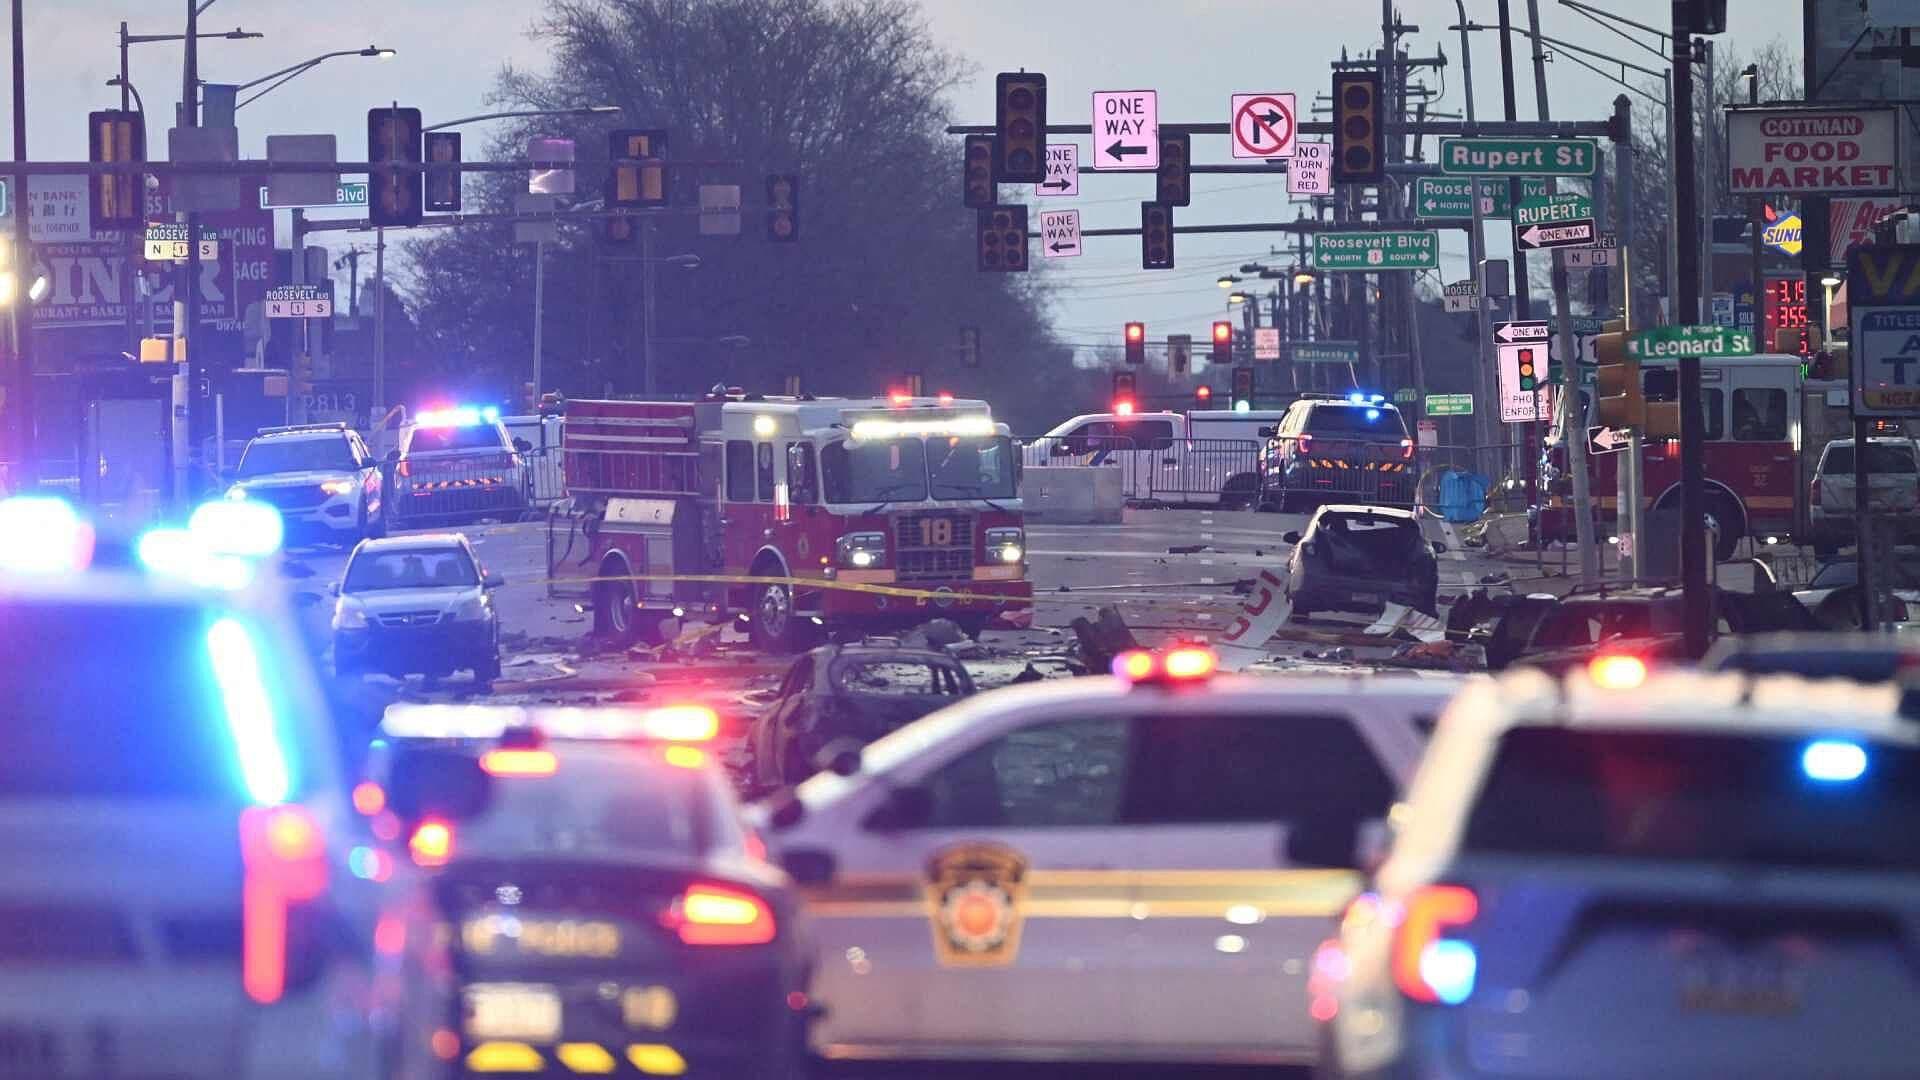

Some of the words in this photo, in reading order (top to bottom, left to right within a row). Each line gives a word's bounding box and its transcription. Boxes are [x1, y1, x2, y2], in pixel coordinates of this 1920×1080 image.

[1105, 98, 1144, 115] ONE
[1105, 119, 1144, 135] WAY
[1764, 118, 1857, 135] COTTMAN
[1299, 146, 1319, 158] NO
[1453, 146, 1543, 169] Rupert
[1556, 146, 1584, 166] St
[1764, 141, 1861, 163] FOOD
[1295, 160, 1323, 169] TURN
[1301, 170, 1316, 180] ON
[1731, 165, 1893, 189] MARKET
[1297, 180, 1319, 190] RED
[1423, 181, 1505, 196] Rooseelt
[336, 187, 364, 202] Blvd
[1440, 200, 1470, 210] NORTH
[1519, 203, 1578, 223] RUPERT
[1580, 206, 1592, 217] ST
[1047, 214, 1074, 227] ONE
[145, 229, 189, 240] ROOSEVE
[1047, 228, 1074, 239] WAY
[1540, 229, 1561, 241] ONE
[1565, 226, 1586, 238] WAY
[1320, 236, 1391, 249] Roosevelt
[1398, 235, 1430, 248] Blvd
[153, 245, 161, 254] N
[201, 245, 210, 255] S
[1390, 253, 1417, 261] SOUTH
[1572, 253, 1580, 263] N
[266, 290, 314, 300] ROOSEVELT
[1444, 286, 1479, 296] ROOSEV
[272, 304, 281, 313] N
[316, 303, 324, 313] S
[1452, 299, 1460, 308] N
[32, 307, 80, 321] AURANT
[1512, 328, 1532, 337] ONE
[1533, 327, 1546, 336] WA
[1644, 335, 1723, 356] Leonard
[1731, 335, 1751, 353] St
[1513, 394, 1544, 403] PHOO
[920, 517, 952, 545] 18
